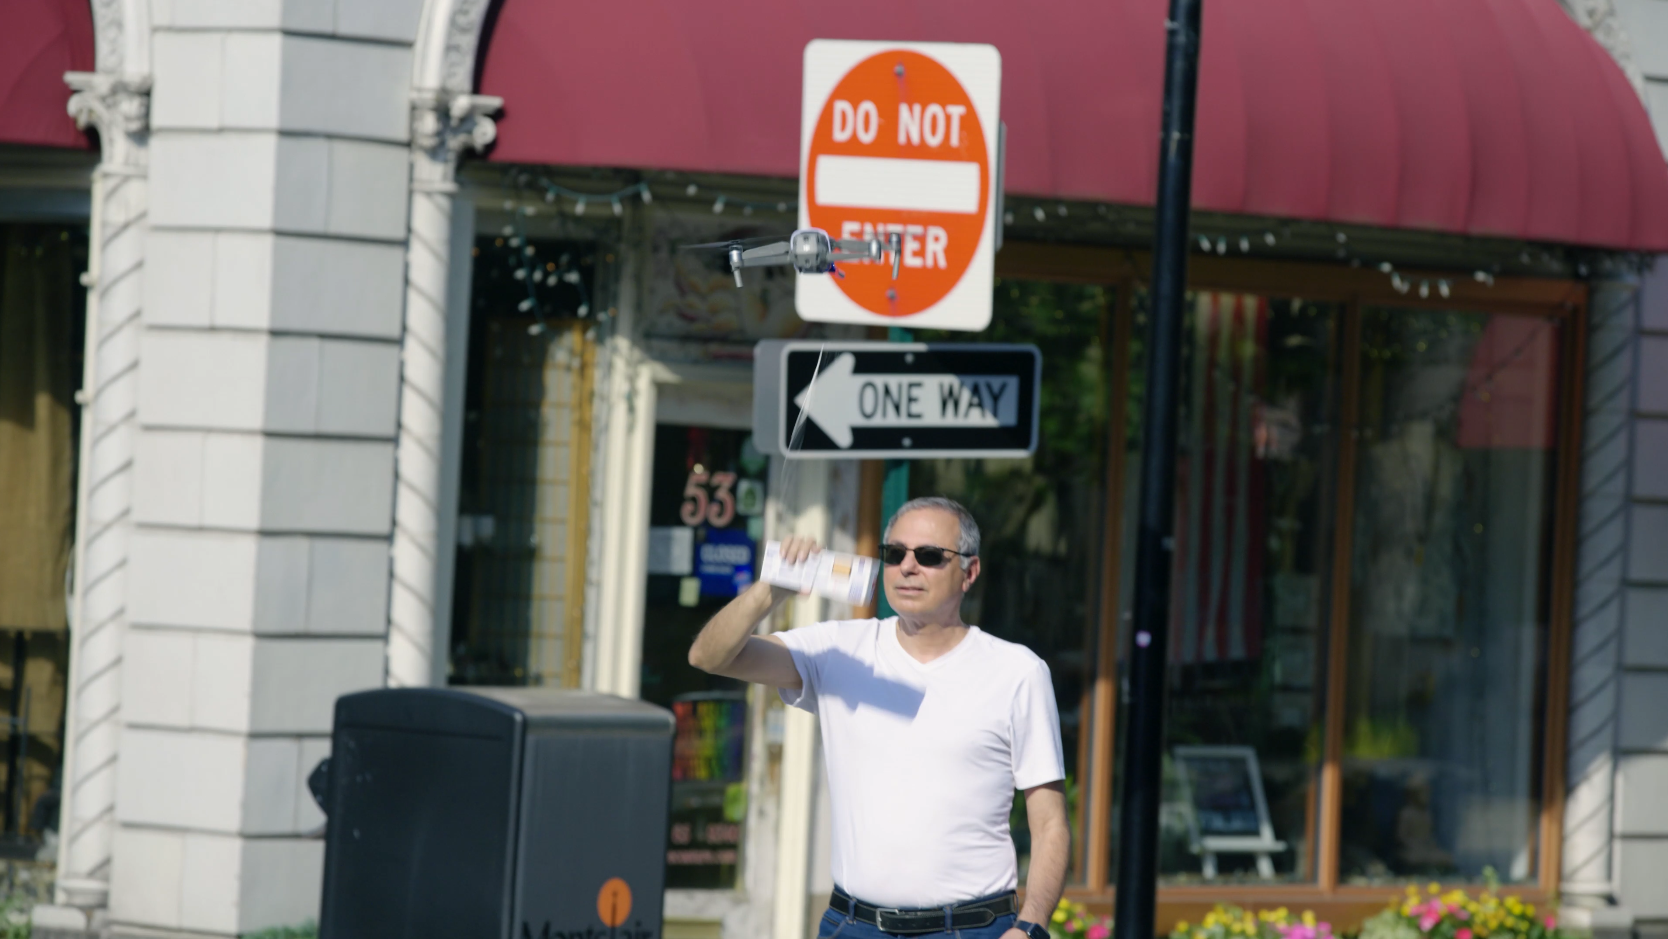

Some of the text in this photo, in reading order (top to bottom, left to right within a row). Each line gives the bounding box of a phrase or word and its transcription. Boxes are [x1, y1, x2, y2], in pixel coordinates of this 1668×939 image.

[832, 99, 967, 148] DO NOT
[858, 380, 1008, 420] ONE WAY
[680, 471, 738, 528] 53
